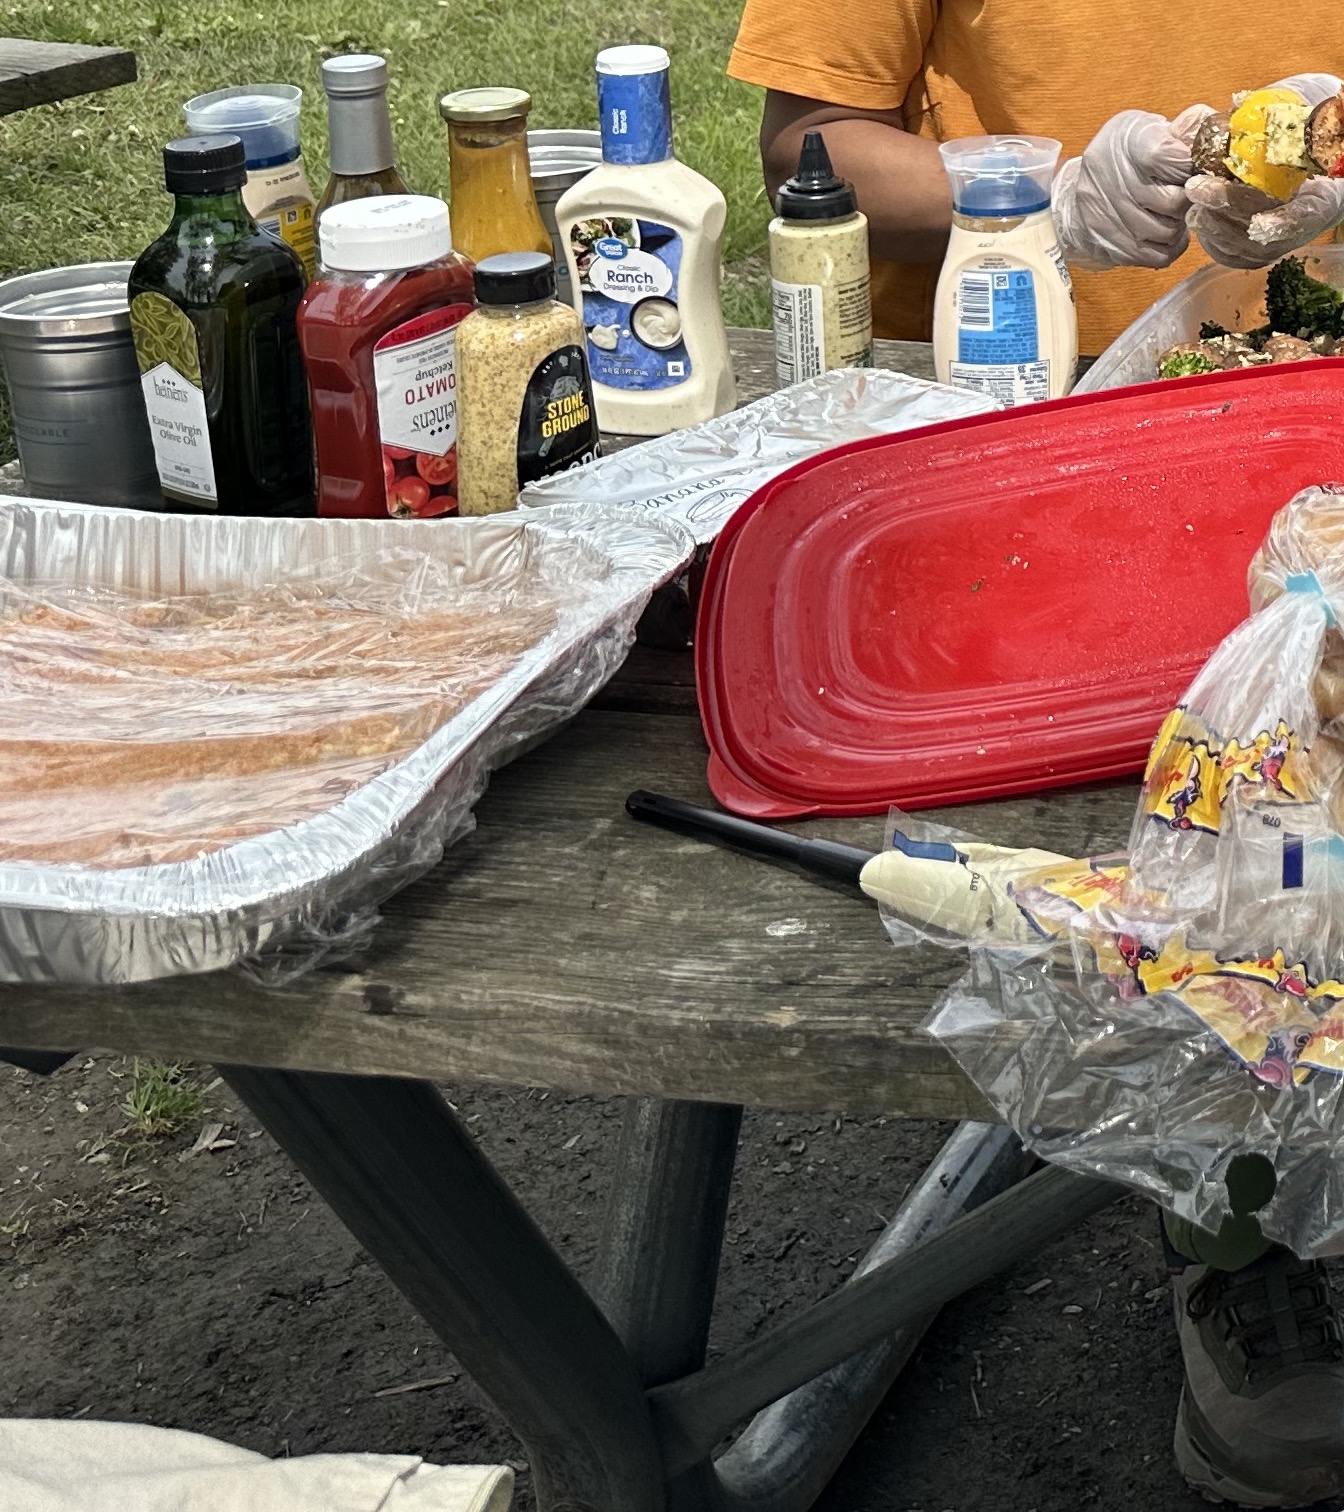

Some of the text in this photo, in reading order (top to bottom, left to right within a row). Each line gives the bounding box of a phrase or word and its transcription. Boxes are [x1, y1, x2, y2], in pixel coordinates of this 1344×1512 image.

[600, 242, 622, 252] Great
[607, 270, 653, 284] Ranch
[604, 283, 659, 293] Dressing & Dip
[415, 360, 453, 381] Ketchup
[405, 374, 456, 405] OMATO
[547, 390, 584, 420] STONE
[152, 415, 202, 437] Extra Virgin
[542, 404, 590, 438] GROUND
[160, 430, 197, 446] Olive Oil
[617, 477, 725, 510] Banana
